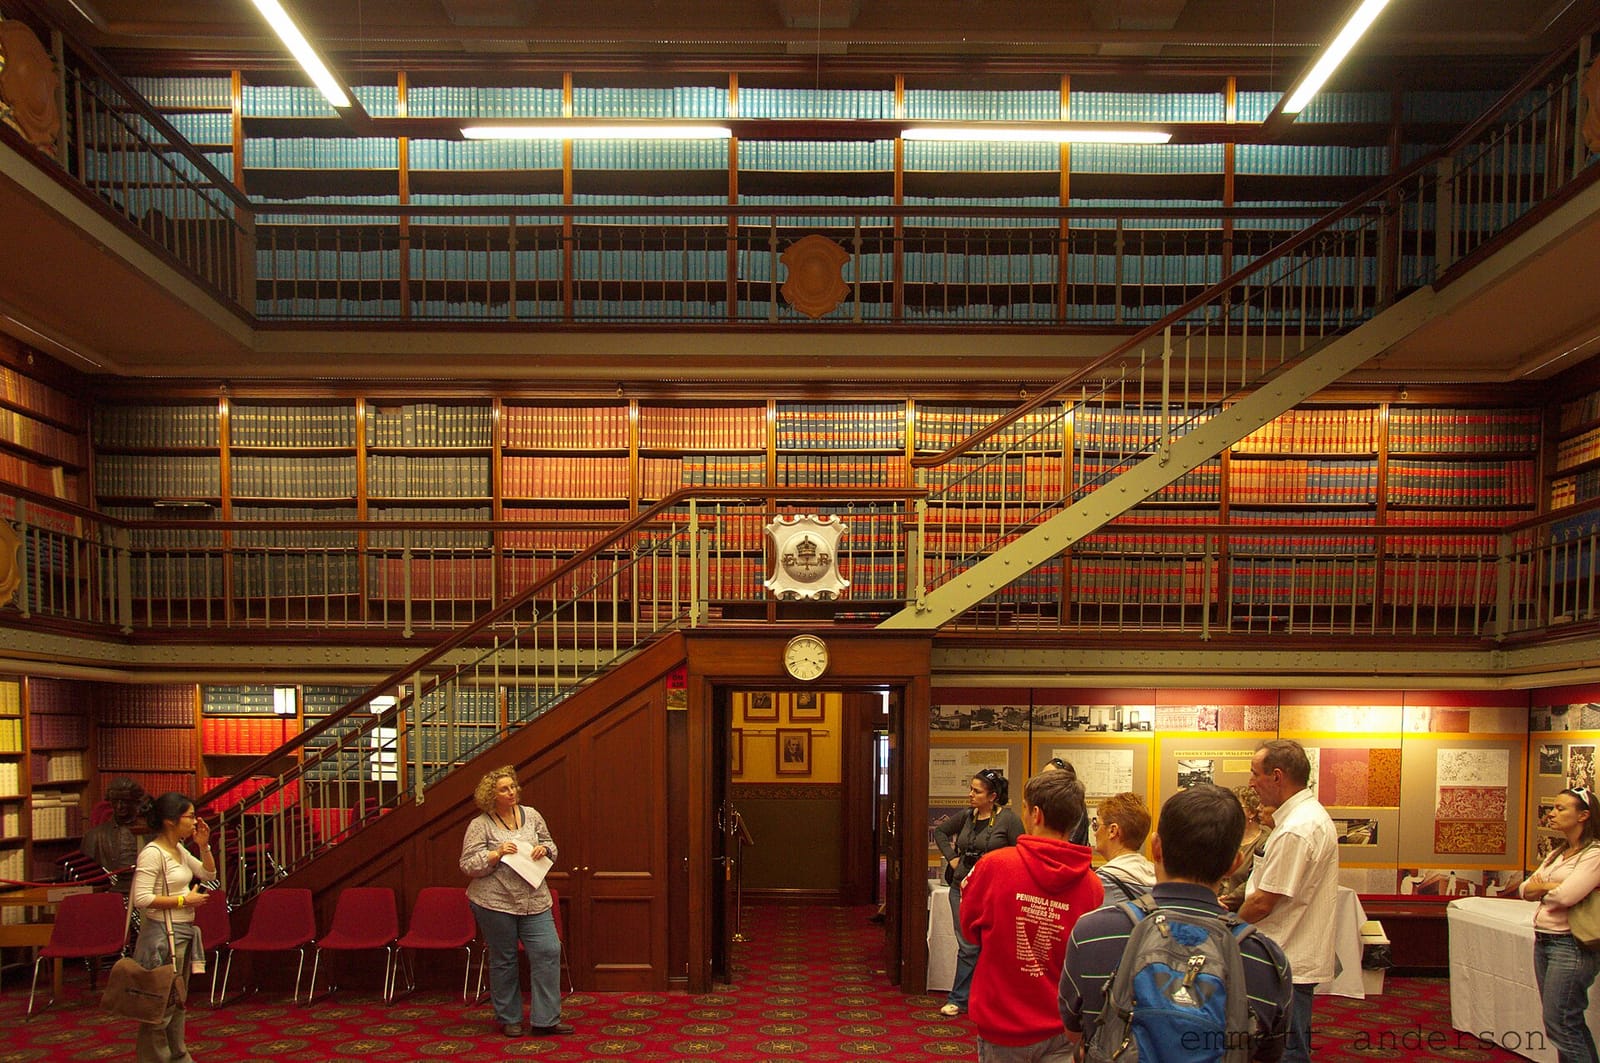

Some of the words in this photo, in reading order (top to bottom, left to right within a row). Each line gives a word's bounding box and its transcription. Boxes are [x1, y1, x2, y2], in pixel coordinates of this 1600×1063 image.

[1016, 893, 1049, 907] PENINSULA
[1050, 900, 1070, 911] SWANS
[1020, 905, 1048, 917] PREMIERS
